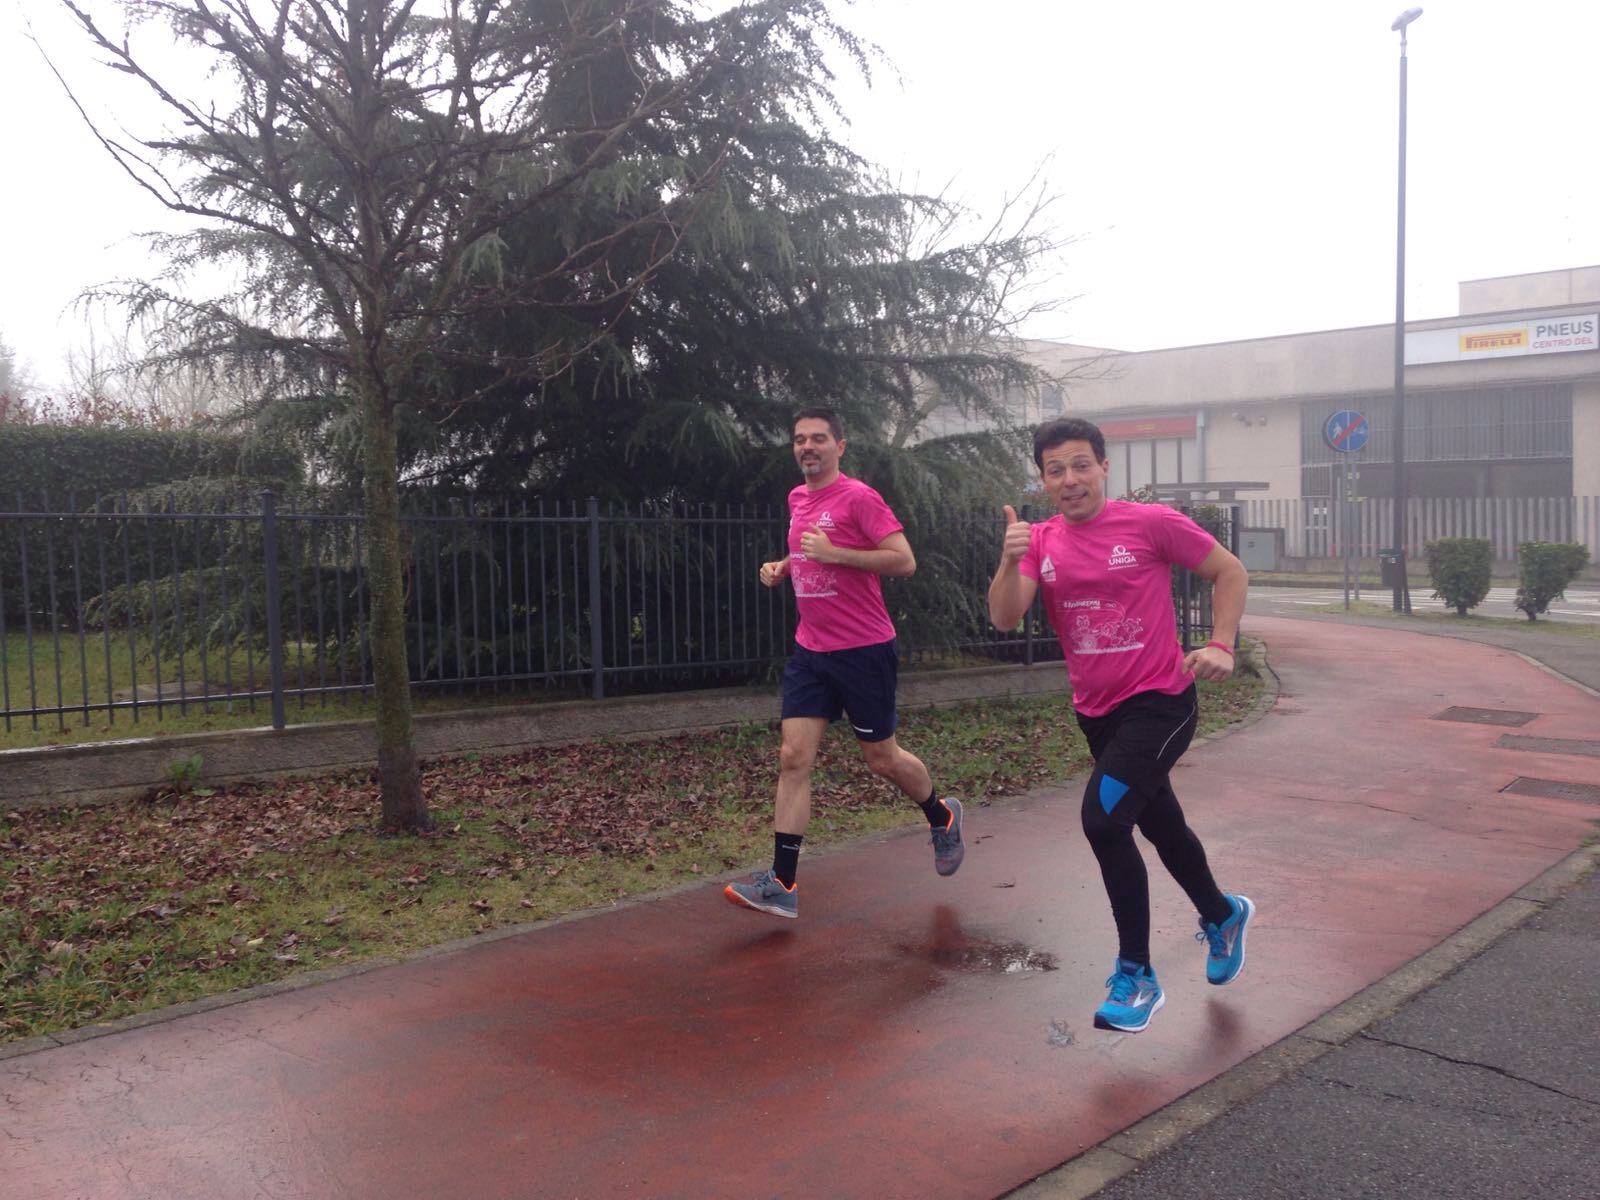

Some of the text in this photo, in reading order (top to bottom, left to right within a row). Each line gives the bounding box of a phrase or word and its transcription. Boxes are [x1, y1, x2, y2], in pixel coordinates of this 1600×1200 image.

[1536, 322, 1593, 338] PNEUS
[1466, 333, 1522, 349] PIRELLI
[1533, 337, 1593, 349] CENTRO DEL
[1109, 556, 1137, 565] UNIQA
